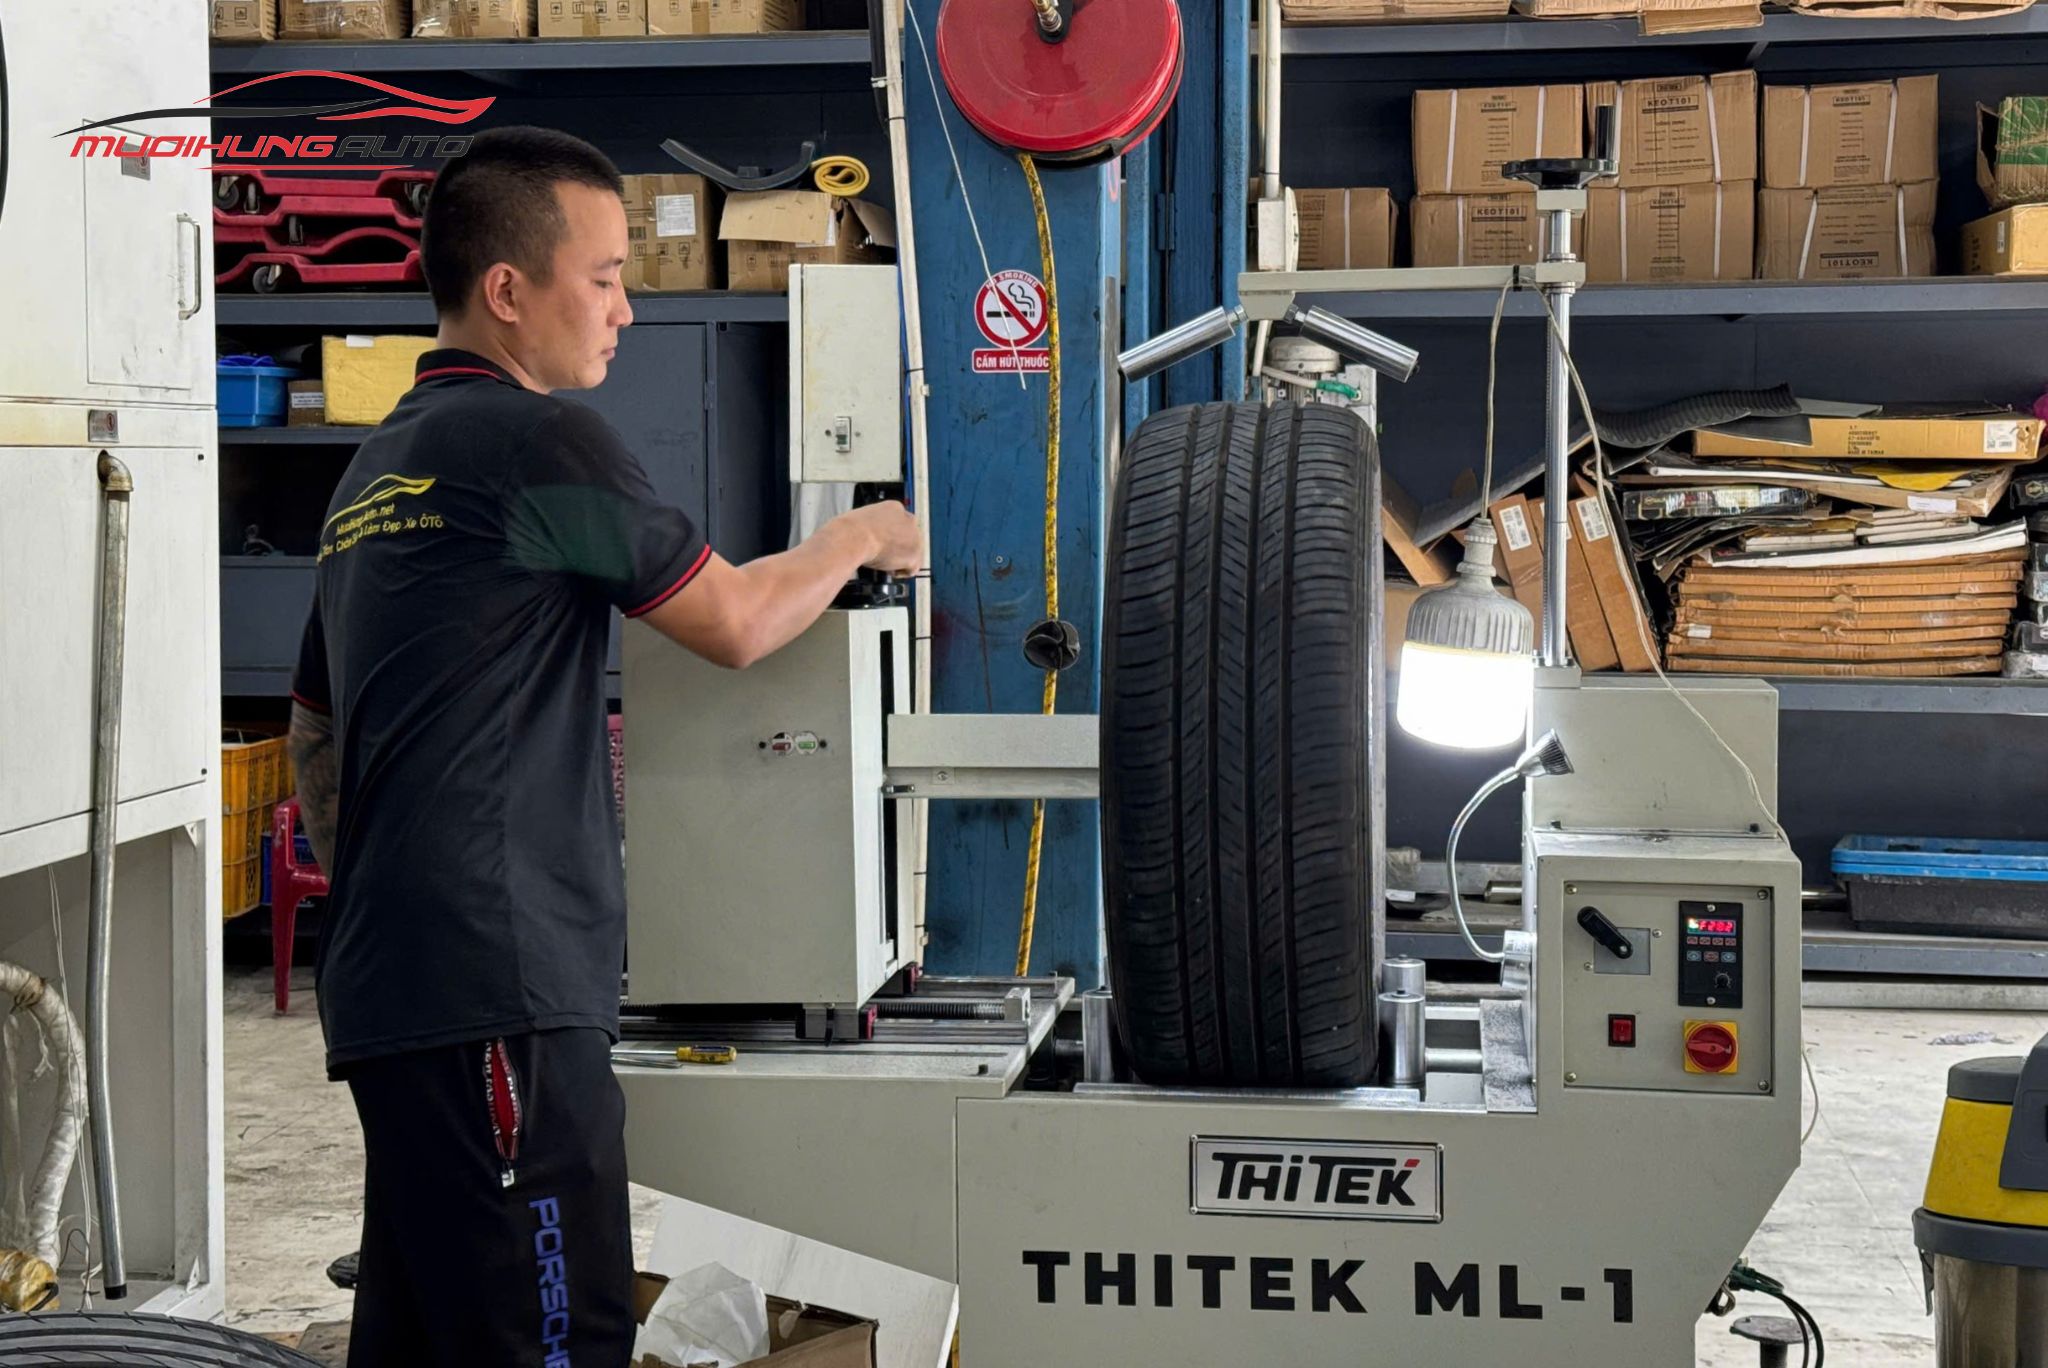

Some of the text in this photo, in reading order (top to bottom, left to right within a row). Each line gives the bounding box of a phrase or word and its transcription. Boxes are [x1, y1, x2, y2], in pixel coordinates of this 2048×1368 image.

[1476, 208, 1520, 216] KEOT101
[998, 271, 1039, 289] SMOKING
[403, 516, 418, 530] Xe
[419, 513, 445, 529] ÔTÔ
[1022, 1250, 1633, 1324] THITEK ML-1
